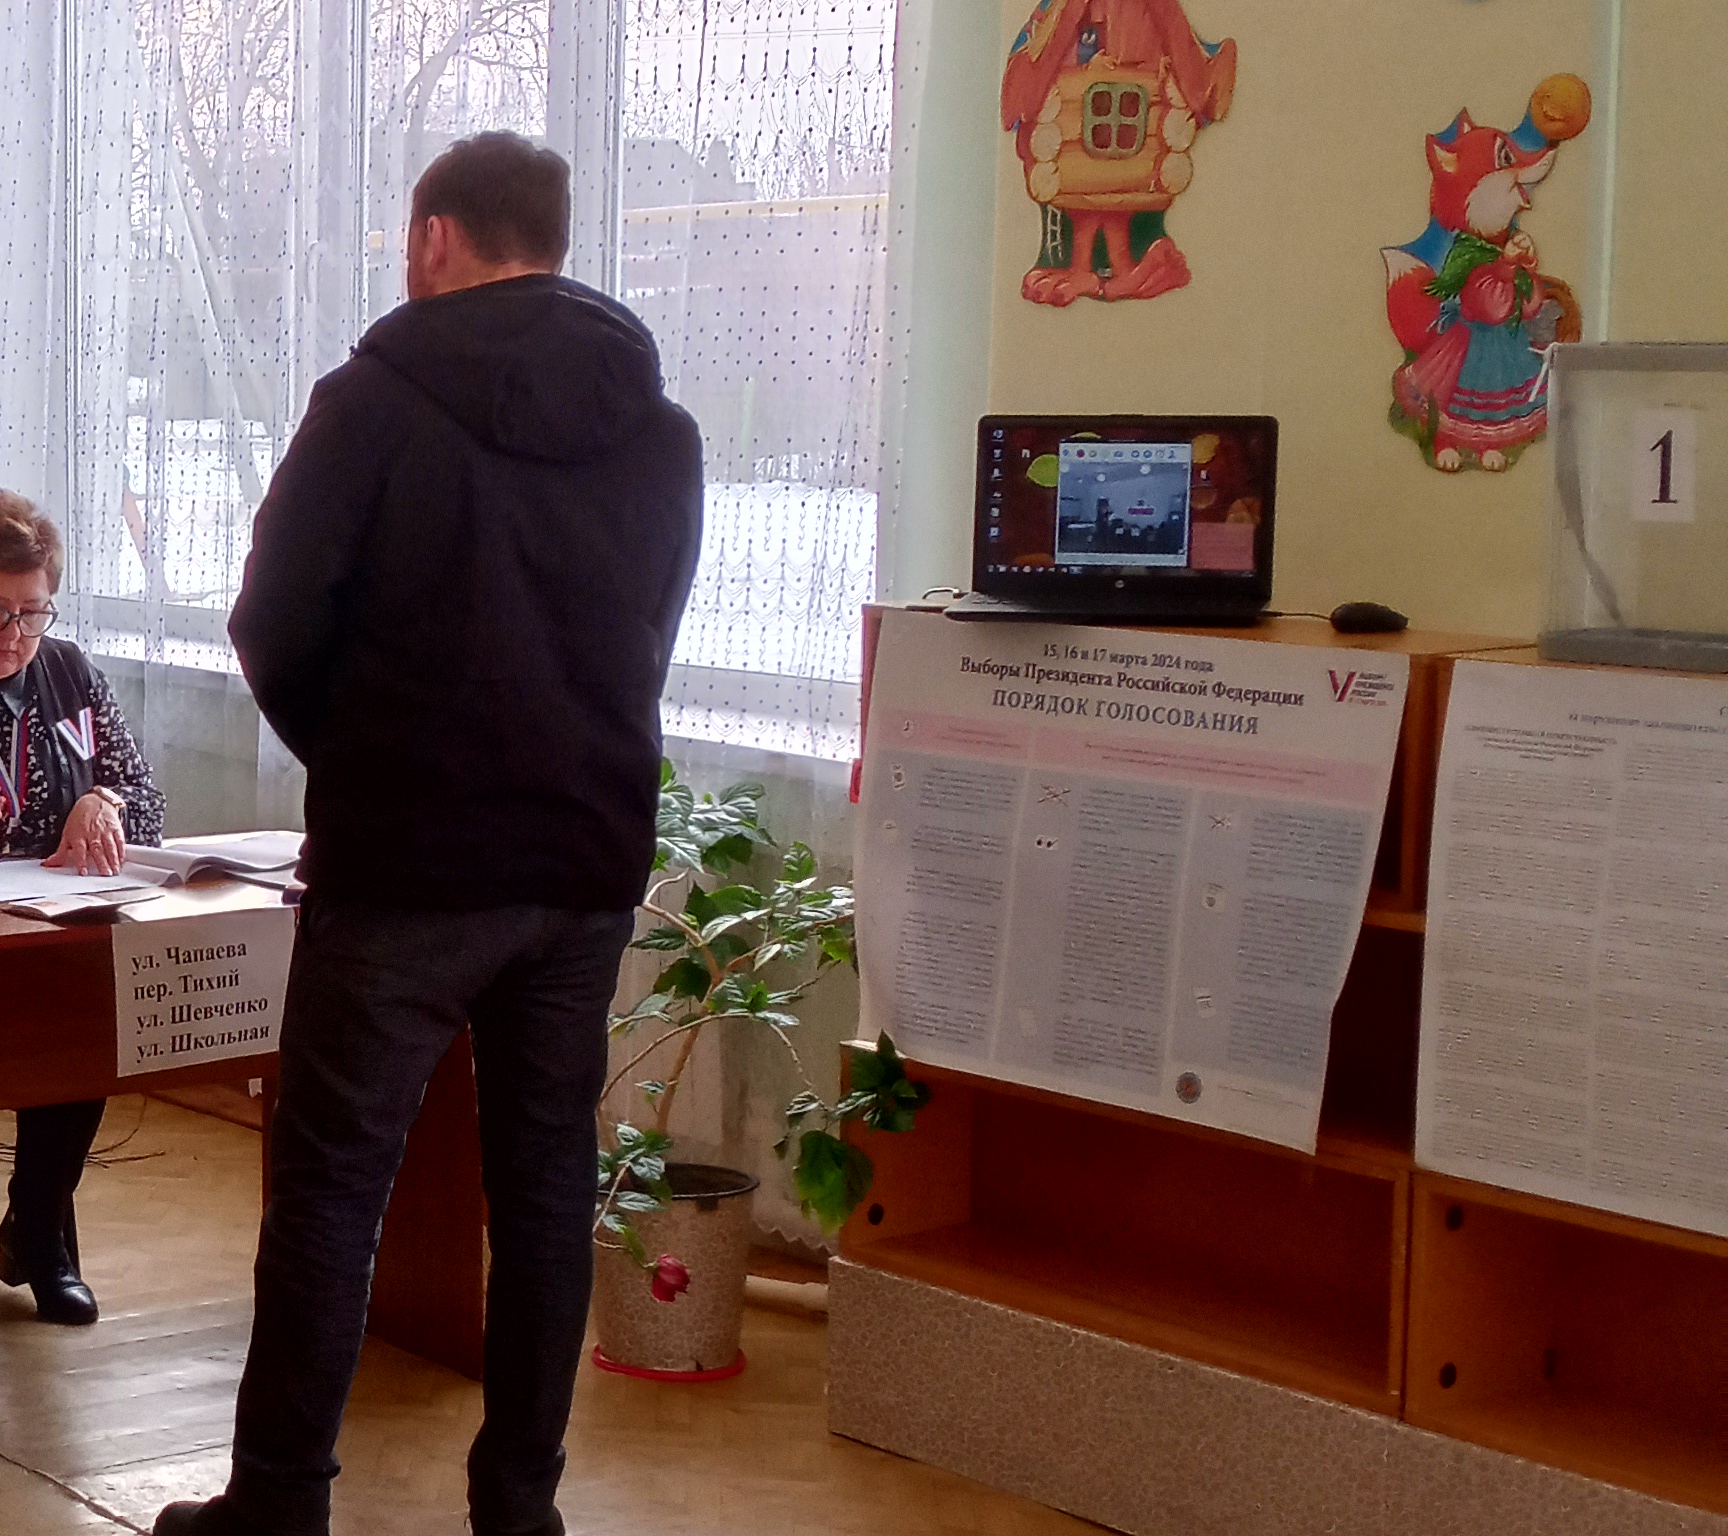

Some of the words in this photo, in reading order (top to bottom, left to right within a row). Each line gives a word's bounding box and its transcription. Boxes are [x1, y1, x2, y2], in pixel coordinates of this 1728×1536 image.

[1650, 429, 1678, 504] 1
[1043, 644, 1060, 660] 15,
[1064, 645, 1079, 660] 16
[1092, 647, 1107, 662] 17
[1109, 652, 1148, 668] марта
[1151, 653, 1183, 670] 2024
[1184, 659, 1214, 673] года
[960, 656, 1020, 680] Выборы
[1024, 662, 1113, 687] Президента
[1117, 672, 1208, 696] Российской
[1212, 679, 1304, 706] Федерации
[992, 689, 1090, 717] ПОРЯДОК
[1095, 700, 1260, 734] ГОЛОСОВАНИЯ
[131, 954, 160, 975] ул.
[165, 941, 248, 965] Чапаева
[134, 980, 173, 1002] пер.
[179, 968, 240, 993] Тихий
[136, 1013, 164, 1034] ул.
[170, 997, 268, 1025] Шевченко
[136, 1043, 165, 1064] ул.
[170, 1024, 270, 1053] Школьная
